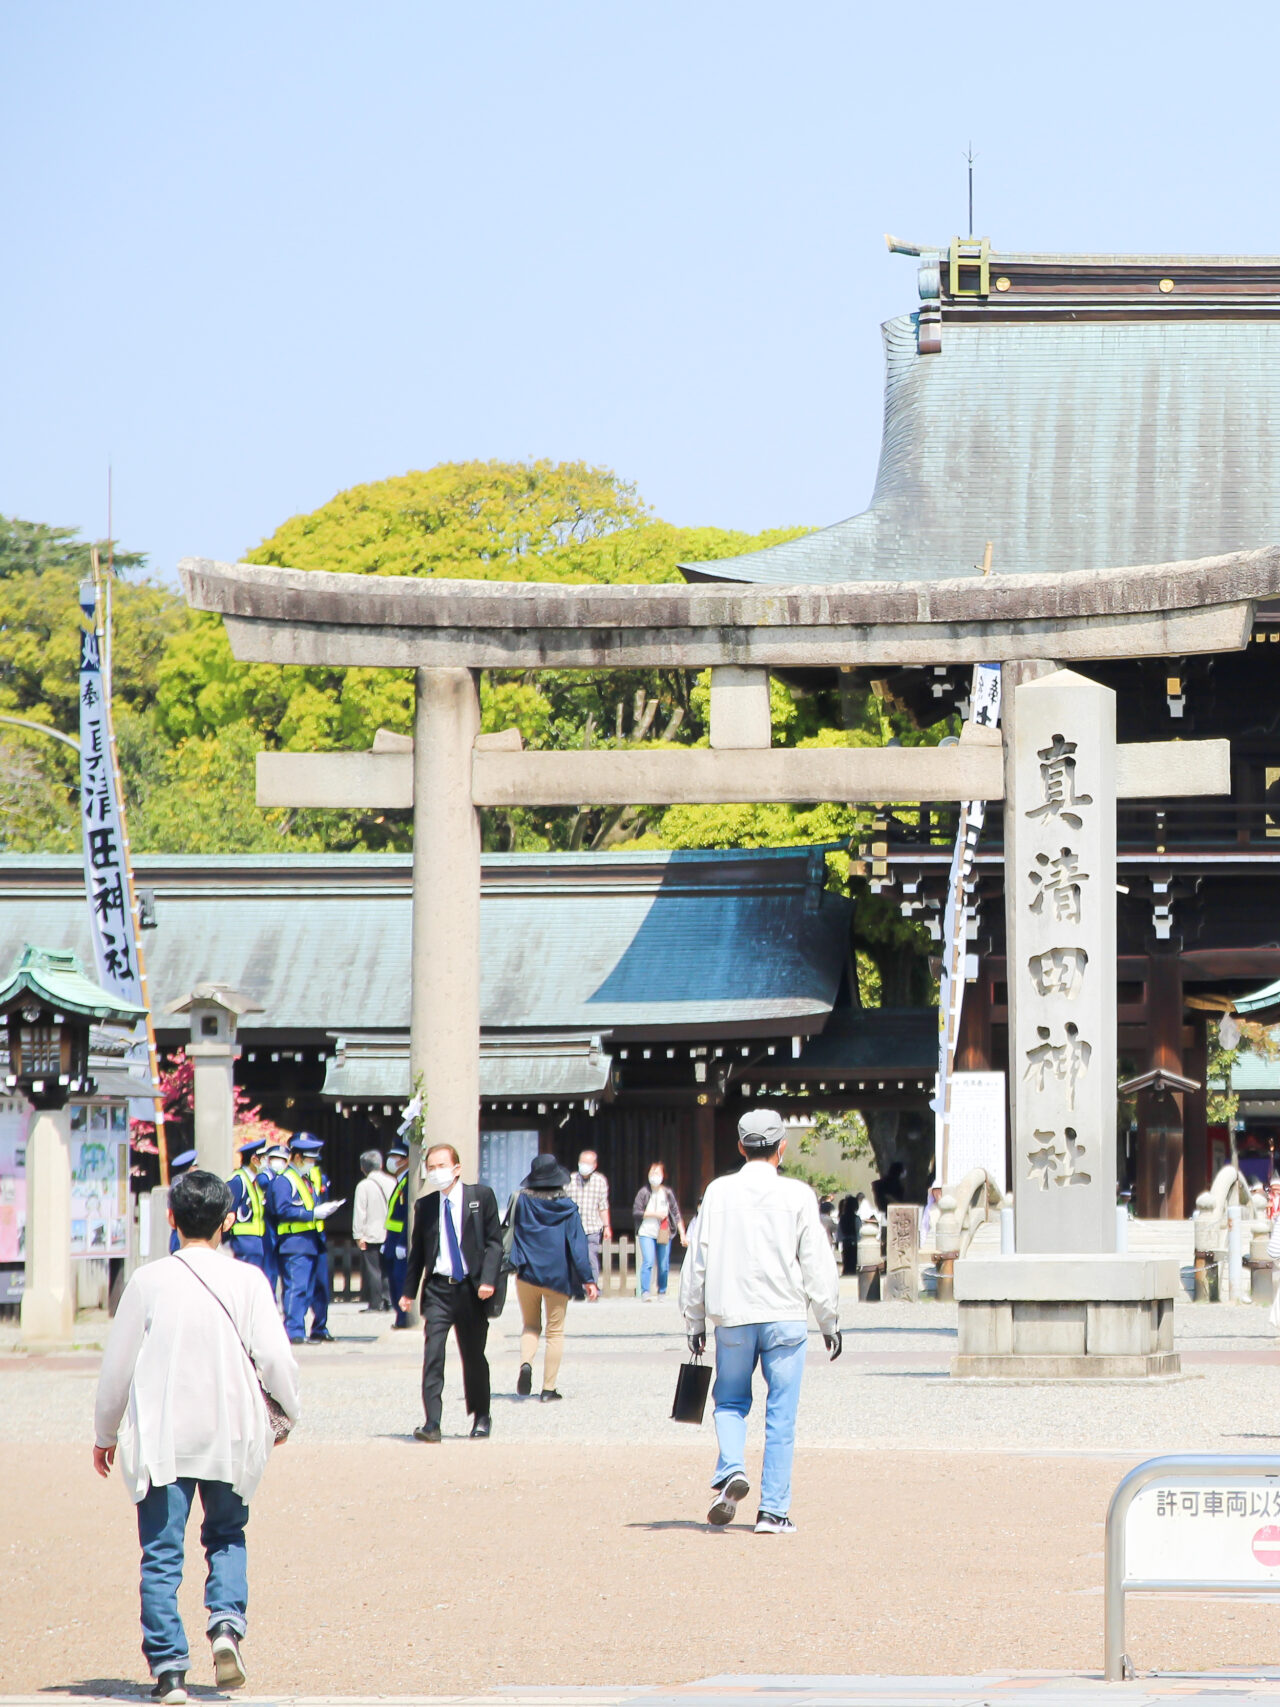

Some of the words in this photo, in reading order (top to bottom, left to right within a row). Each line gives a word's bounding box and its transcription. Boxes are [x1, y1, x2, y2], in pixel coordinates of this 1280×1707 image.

[1022, 733, 1094, 1191] 真清田神社
